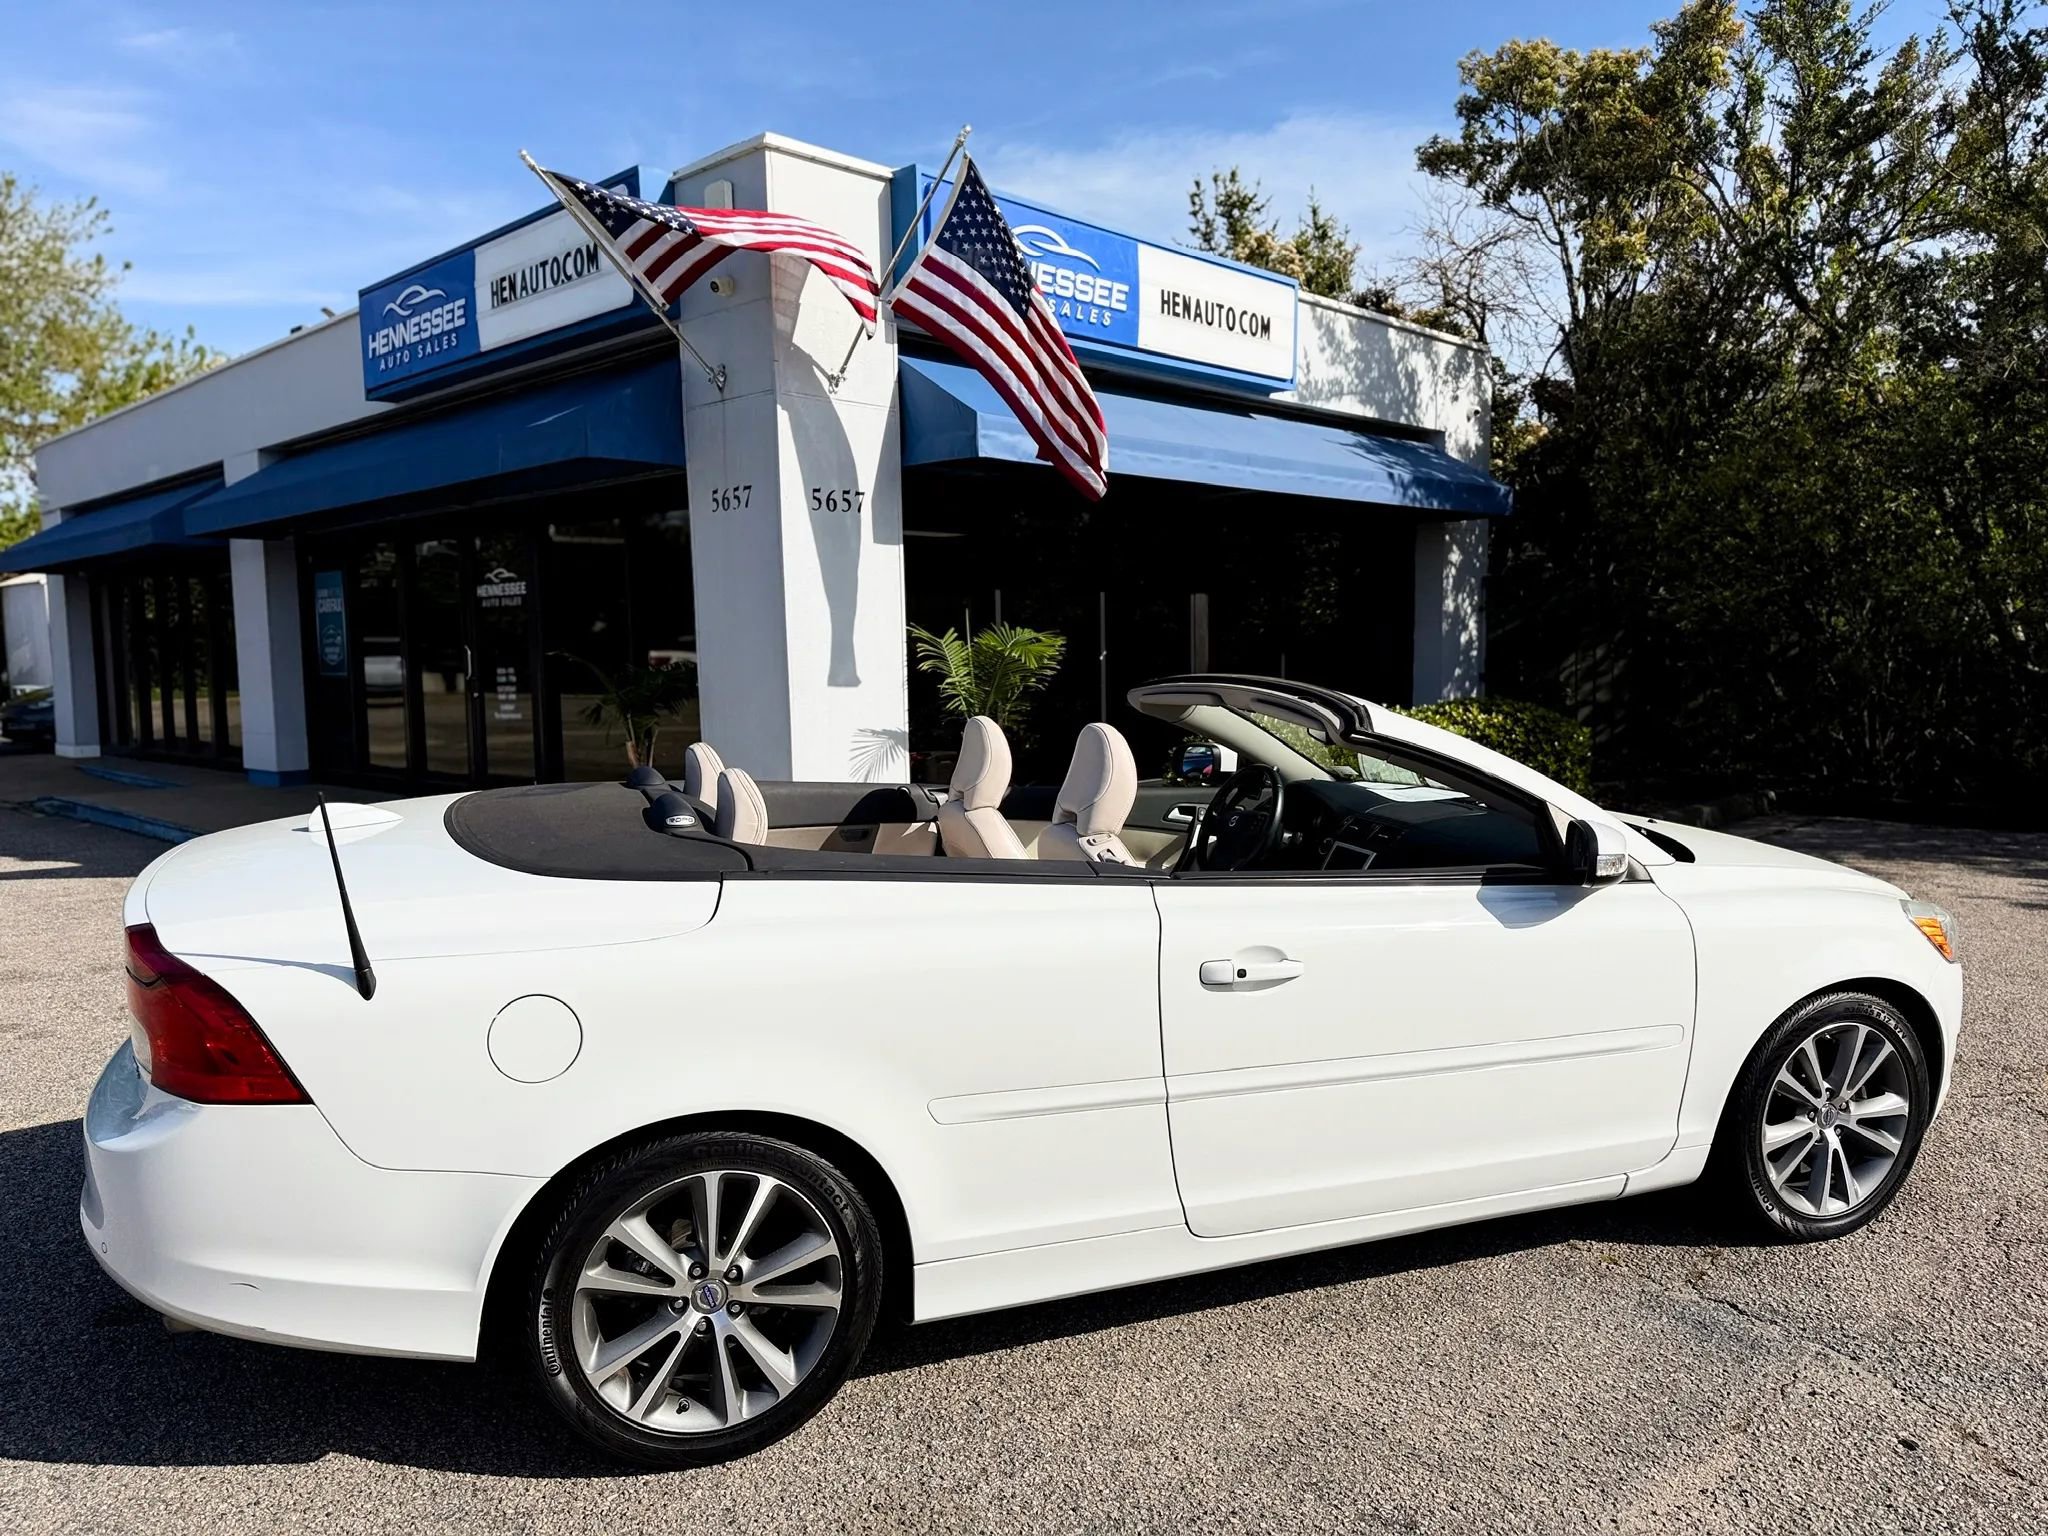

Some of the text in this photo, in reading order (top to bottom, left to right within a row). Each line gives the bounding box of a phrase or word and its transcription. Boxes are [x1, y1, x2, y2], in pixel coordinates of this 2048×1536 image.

[490, 241, 599, 309] HENAUTO.COM
[368, 298, 466, 359] HENNESSEE
[1047, 297, 1113, 328] SALES
[379, 332, 458, 372] AUTO SALES
[711, 485, 752, 512] 5657
[812, 487, 865, 514] 5657
[476, 581, 528, 598] HENNESSEE
[540, 1296, 563, 1378] Continental
